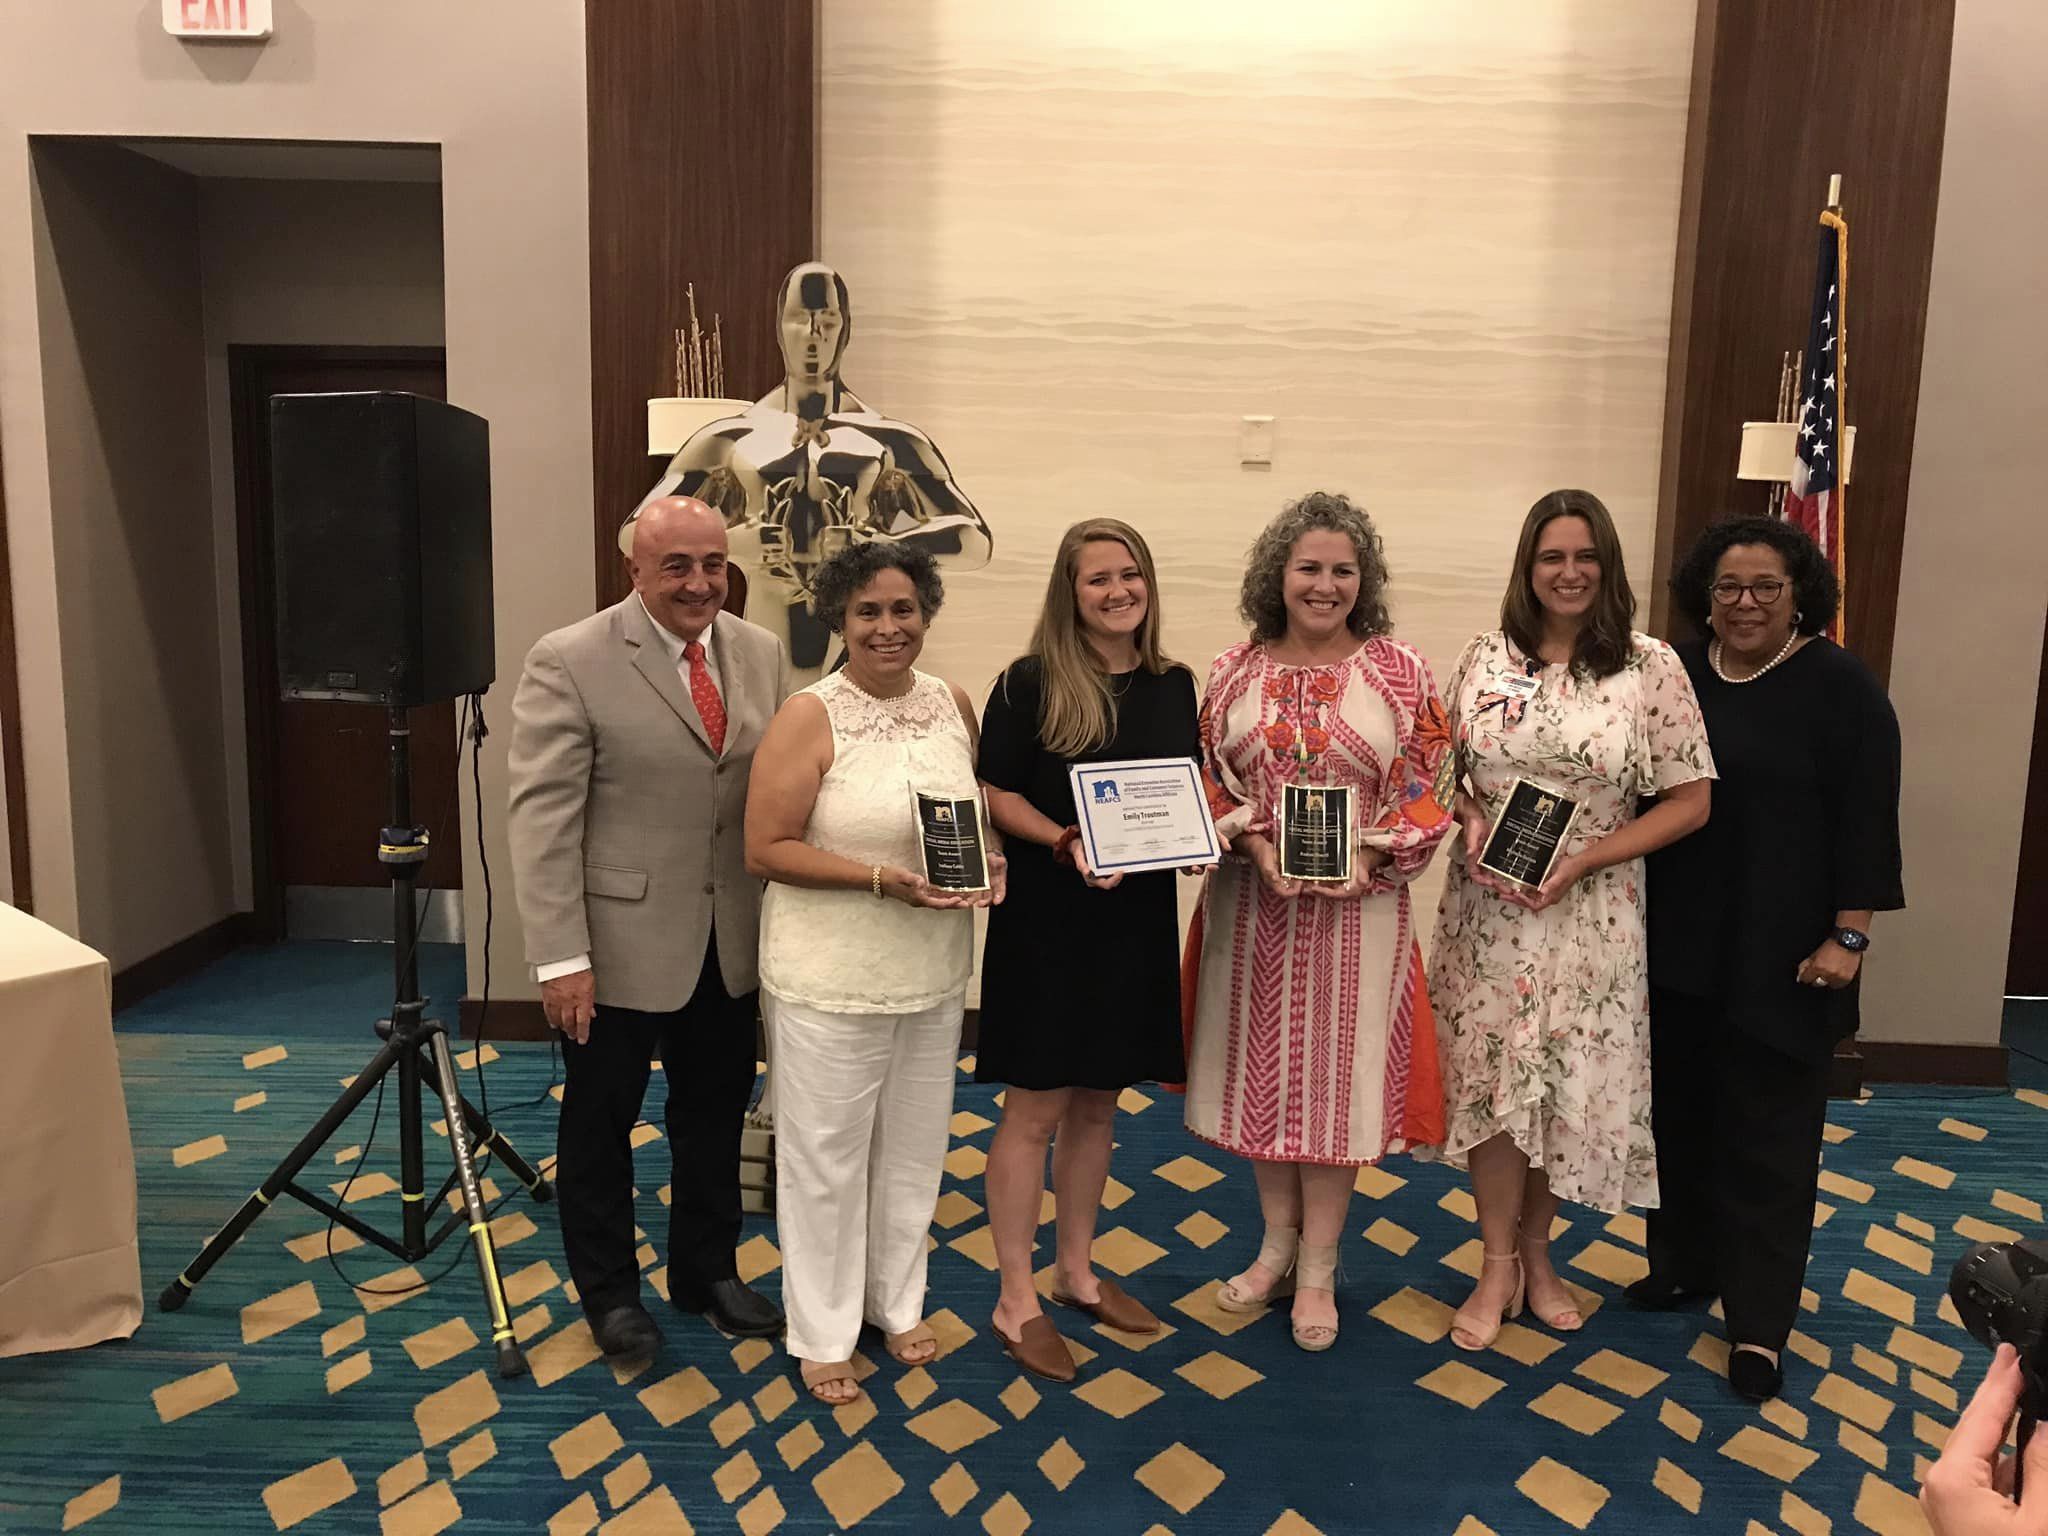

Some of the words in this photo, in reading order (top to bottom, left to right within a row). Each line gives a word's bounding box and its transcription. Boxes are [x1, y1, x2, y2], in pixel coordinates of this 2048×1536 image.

[1123, 812, 1140, 821] Emily
[1140, 811, 1170, 819] Troutman
[446, 1094, 480, 1209] ULTIMATE
